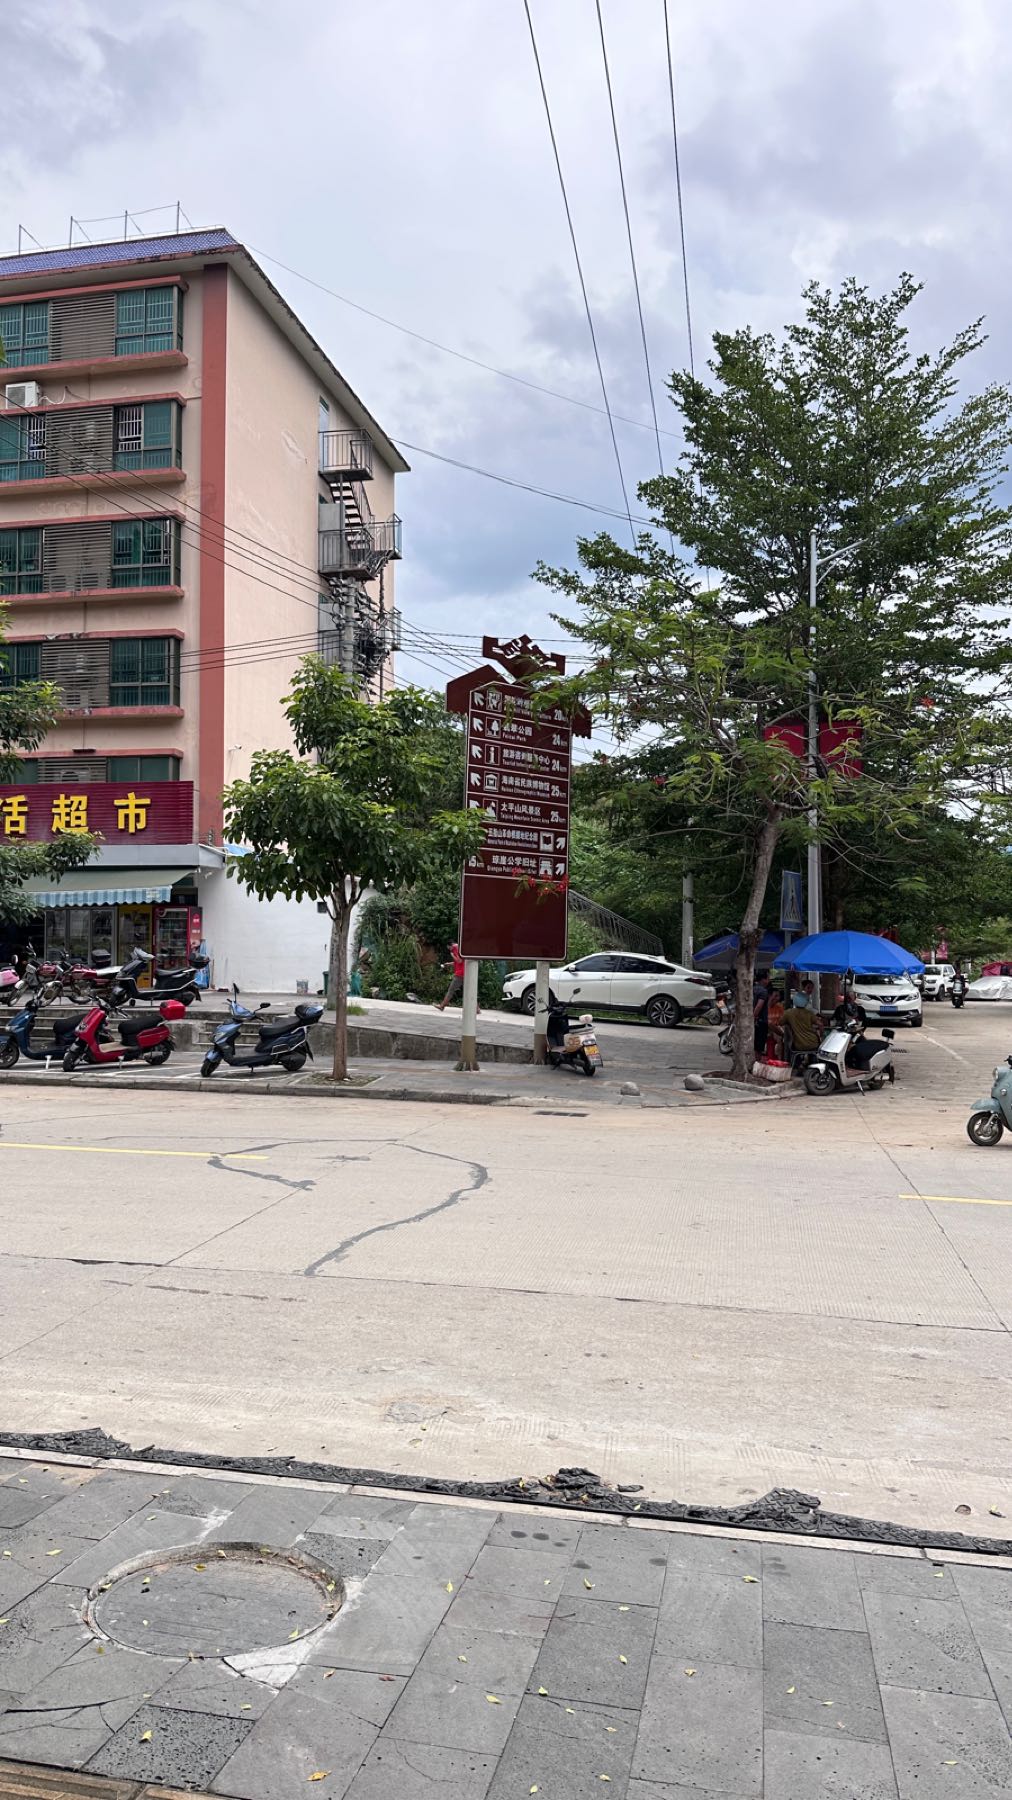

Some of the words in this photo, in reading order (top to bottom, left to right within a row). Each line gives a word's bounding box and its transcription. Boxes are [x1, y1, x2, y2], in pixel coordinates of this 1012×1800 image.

[552, 733, 561, 746] 24
[551, 759, 560, 772] 24
[551, 785, 560, 798] 25
[500, 802, 541, 816] 太平山风景区
[550, 811, 559, 823] 25
